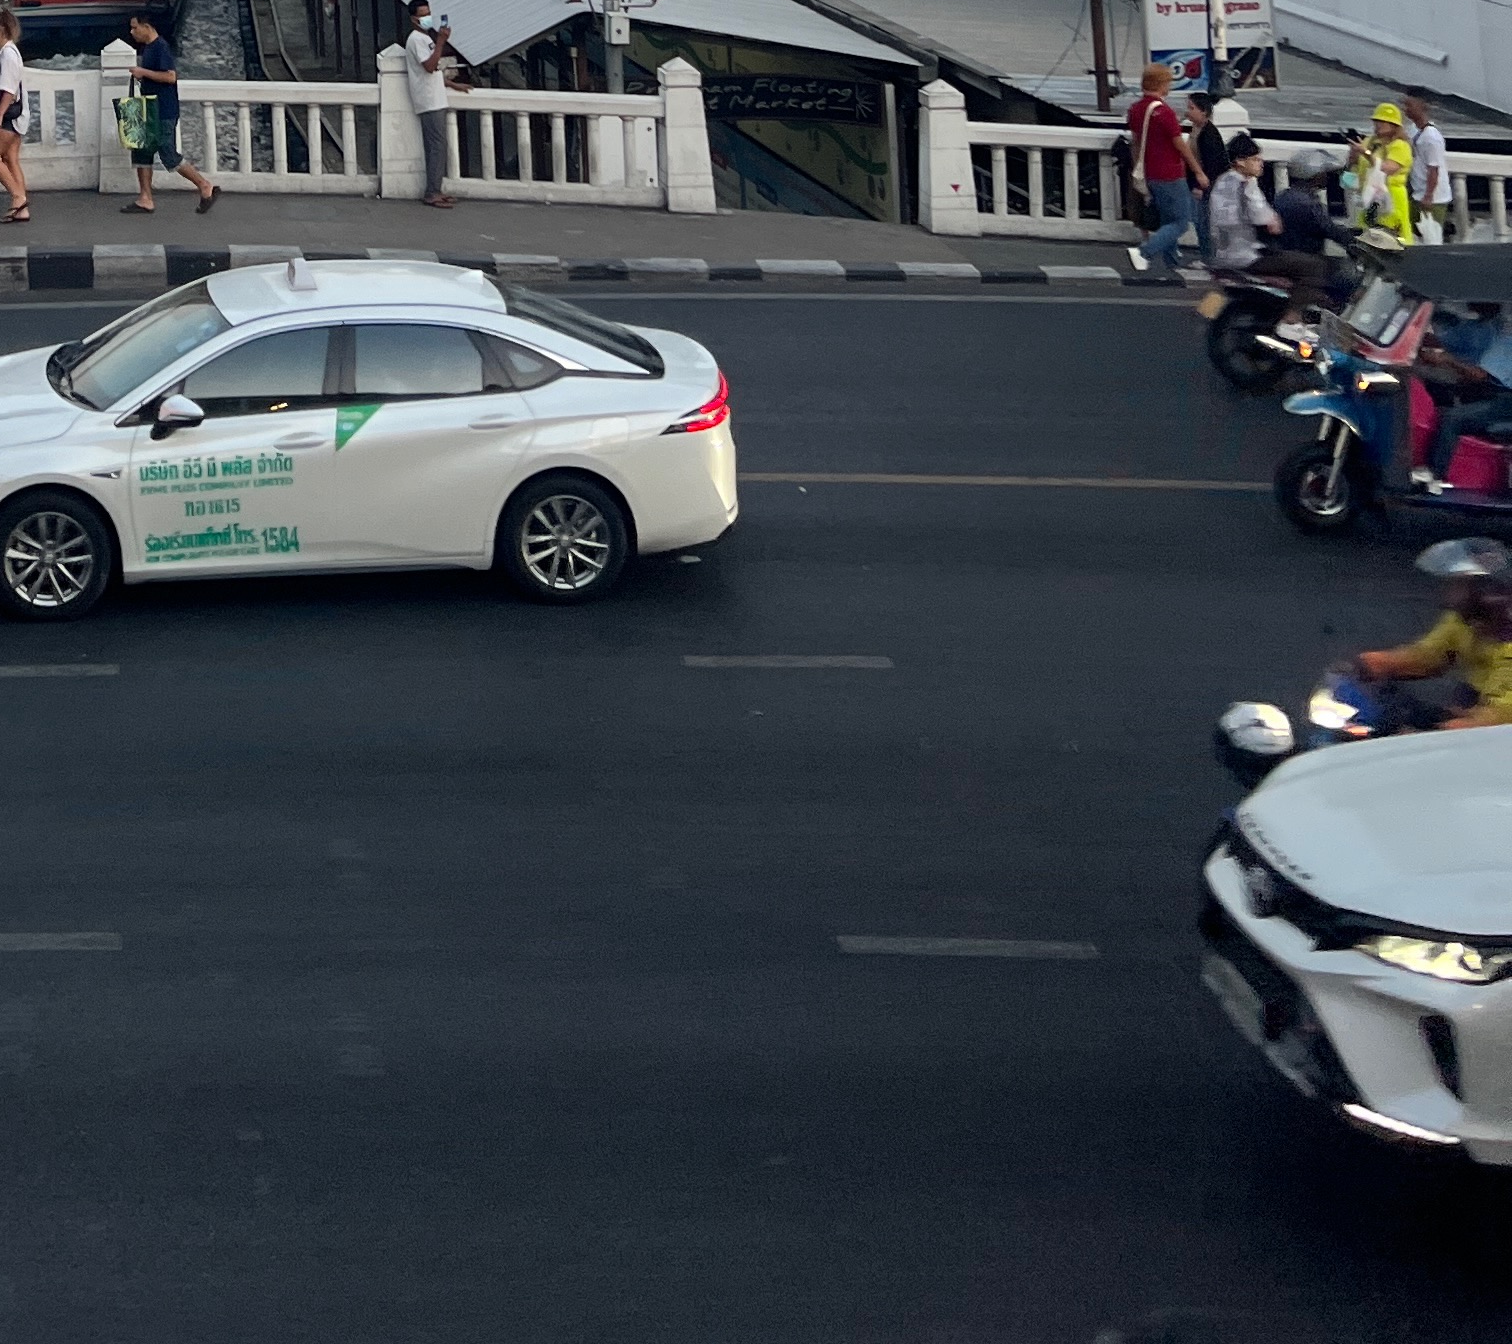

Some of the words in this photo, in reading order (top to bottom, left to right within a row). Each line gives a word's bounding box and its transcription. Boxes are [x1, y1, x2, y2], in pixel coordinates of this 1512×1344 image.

[1156, 2, 1171, 16] by
[754, 78, 852, 102] Floating
[729, 95, 826, 110] Market
[140, 459, 179, 482] บริษัท
[257, 452, 292, 473] จำกัด
[261, 526, 299, 553] 1584
